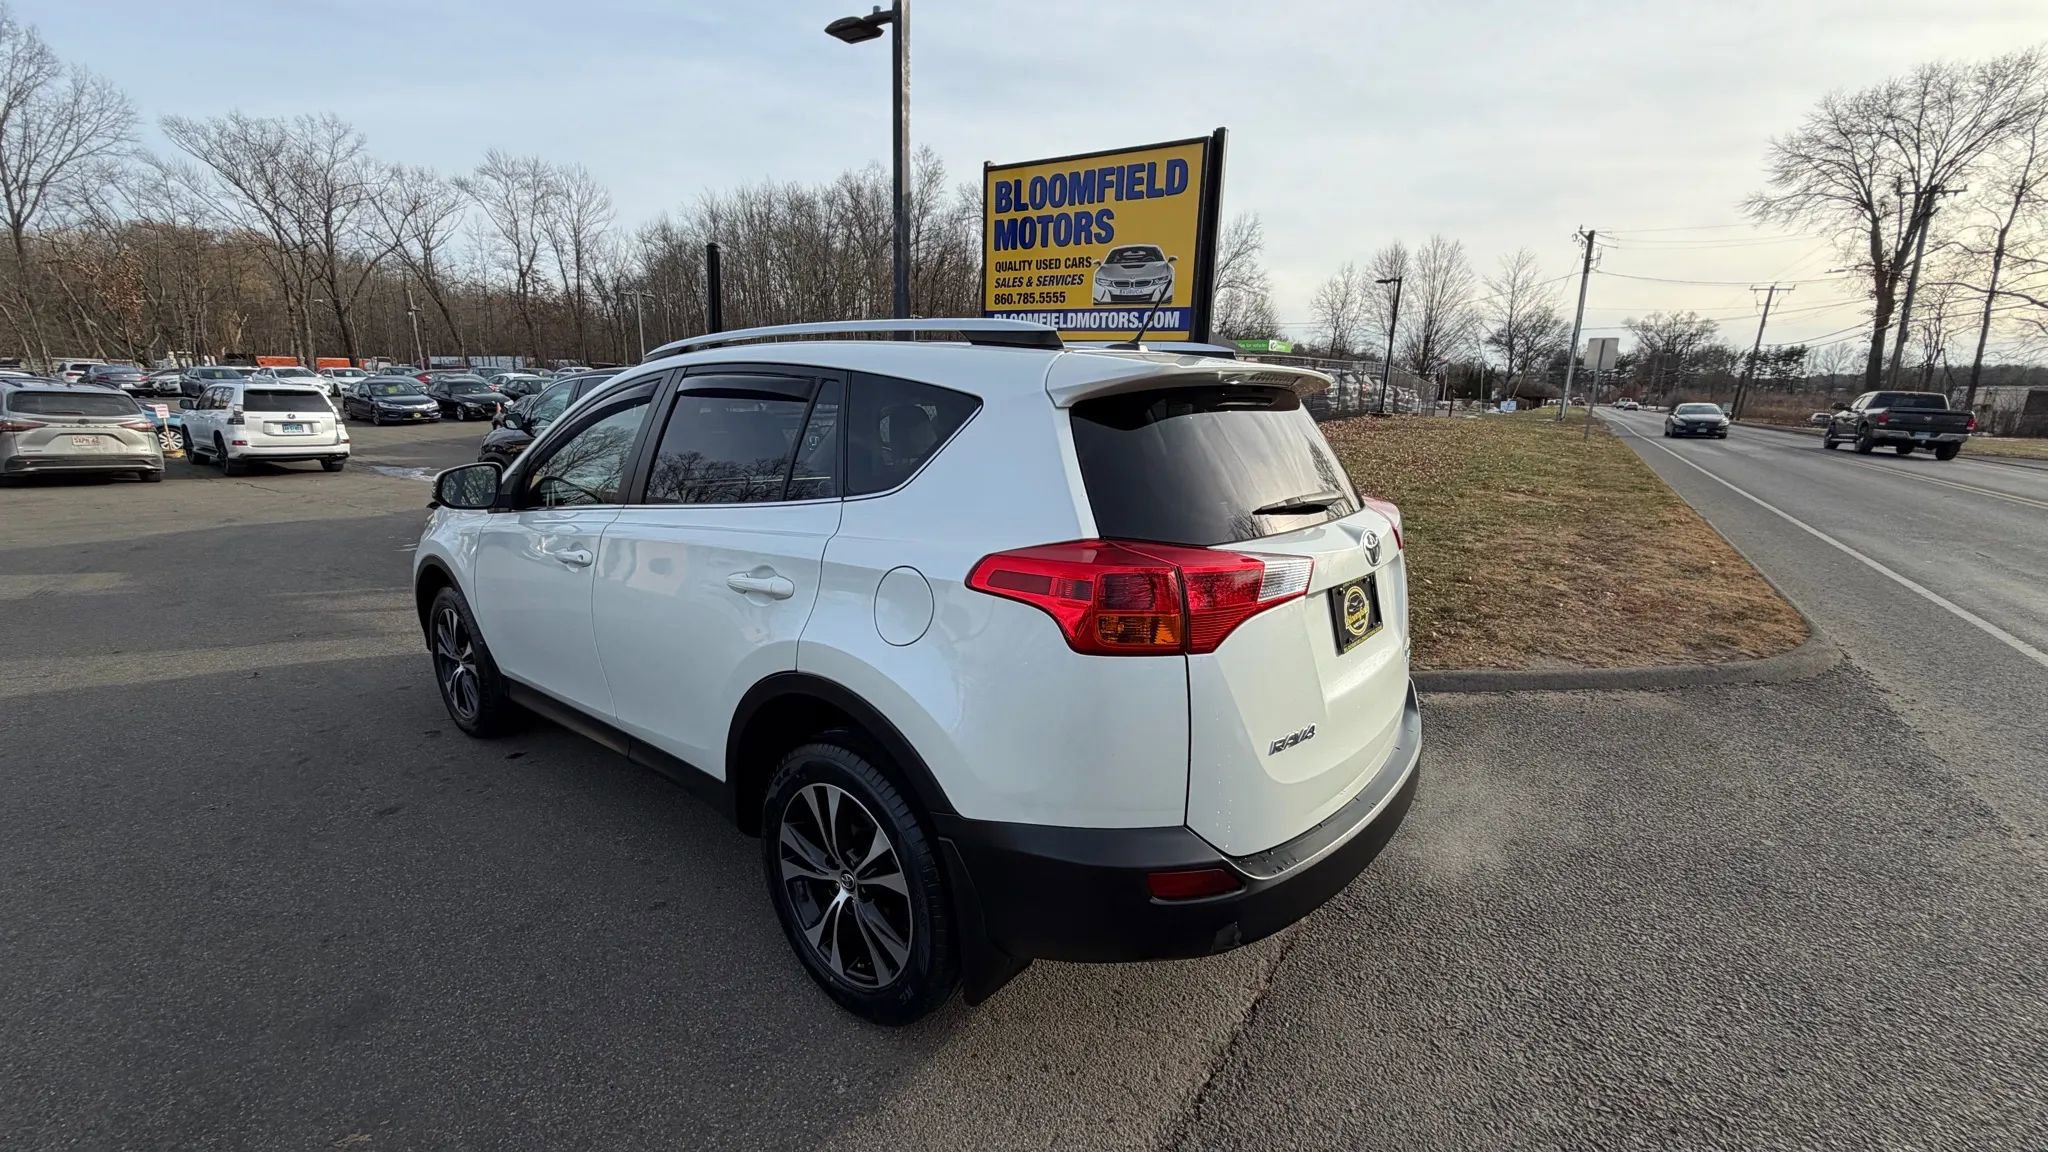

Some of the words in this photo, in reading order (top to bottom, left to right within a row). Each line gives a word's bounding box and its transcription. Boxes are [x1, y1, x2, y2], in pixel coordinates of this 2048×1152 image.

[994, 158, 1189, 214] BLOOMFIELD
[994, 208, 1115, 251] MOTORS
[995, 260, 1033, 273] QUALITY
[1036, 258, 1061, 270] USED
[1064, 256, 1092, 269] CARS
[994, 276, 1024, 288] SALES
[1026, 275, 1033, 287] &
[1036, 273, 1085, 286] SERVICES
[994, 291, 1066, 305] 860.785.5555
[1268, 723, 1316, 756] RAV4
